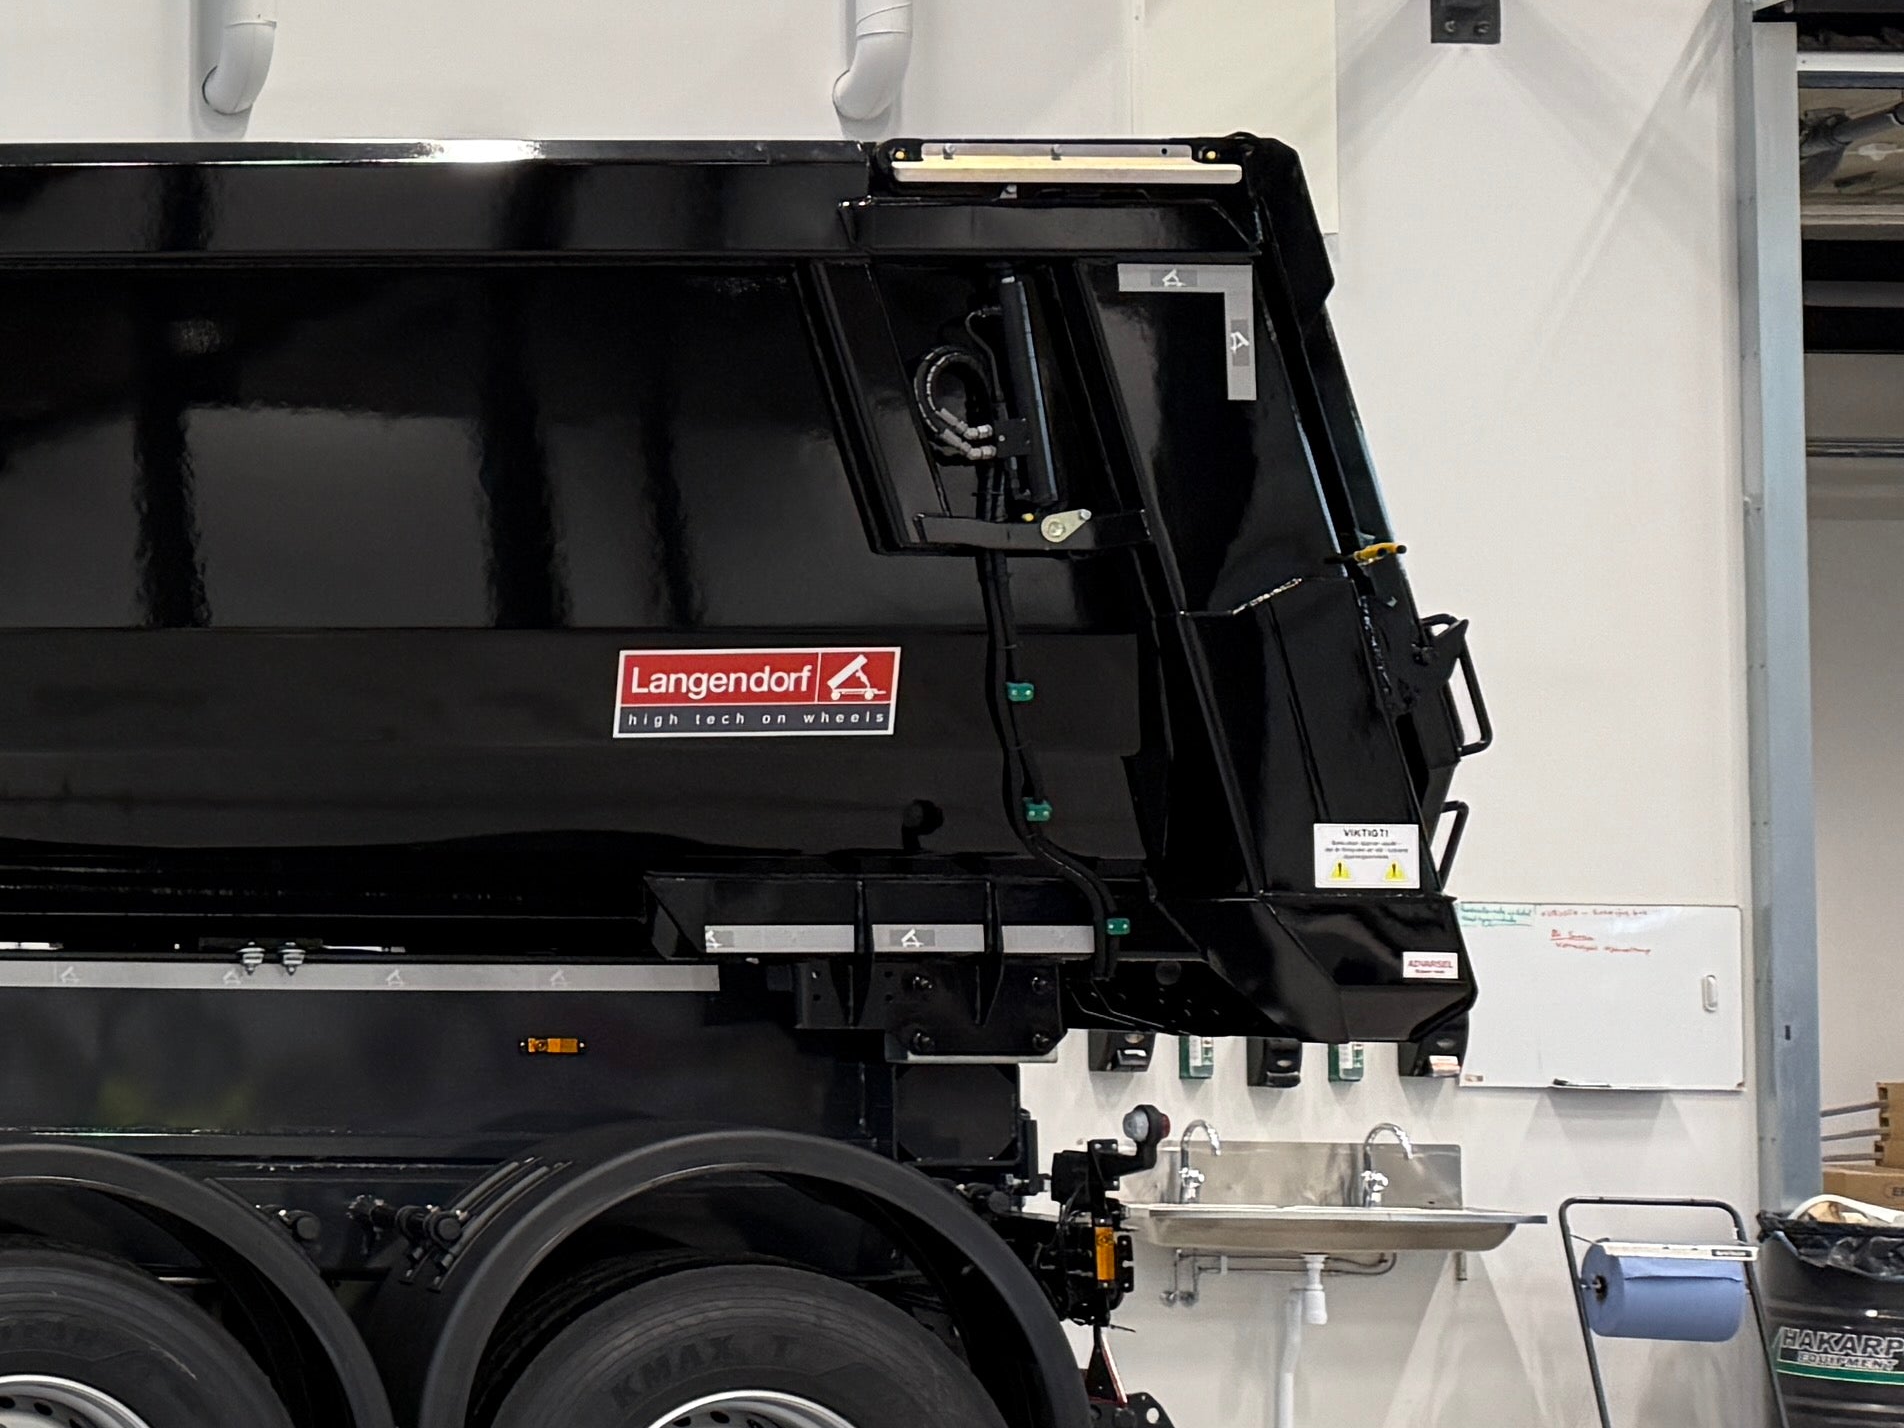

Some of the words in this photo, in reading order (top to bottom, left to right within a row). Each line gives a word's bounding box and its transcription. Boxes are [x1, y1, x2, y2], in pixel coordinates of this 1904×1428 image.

[631, 665, 812, 700] Langendorf
[628, 713, 679, 729] high
[695, 712, 745, 726] tech
[762, 712, 786, 724] on
[803, 709, 885, 725] wheels
